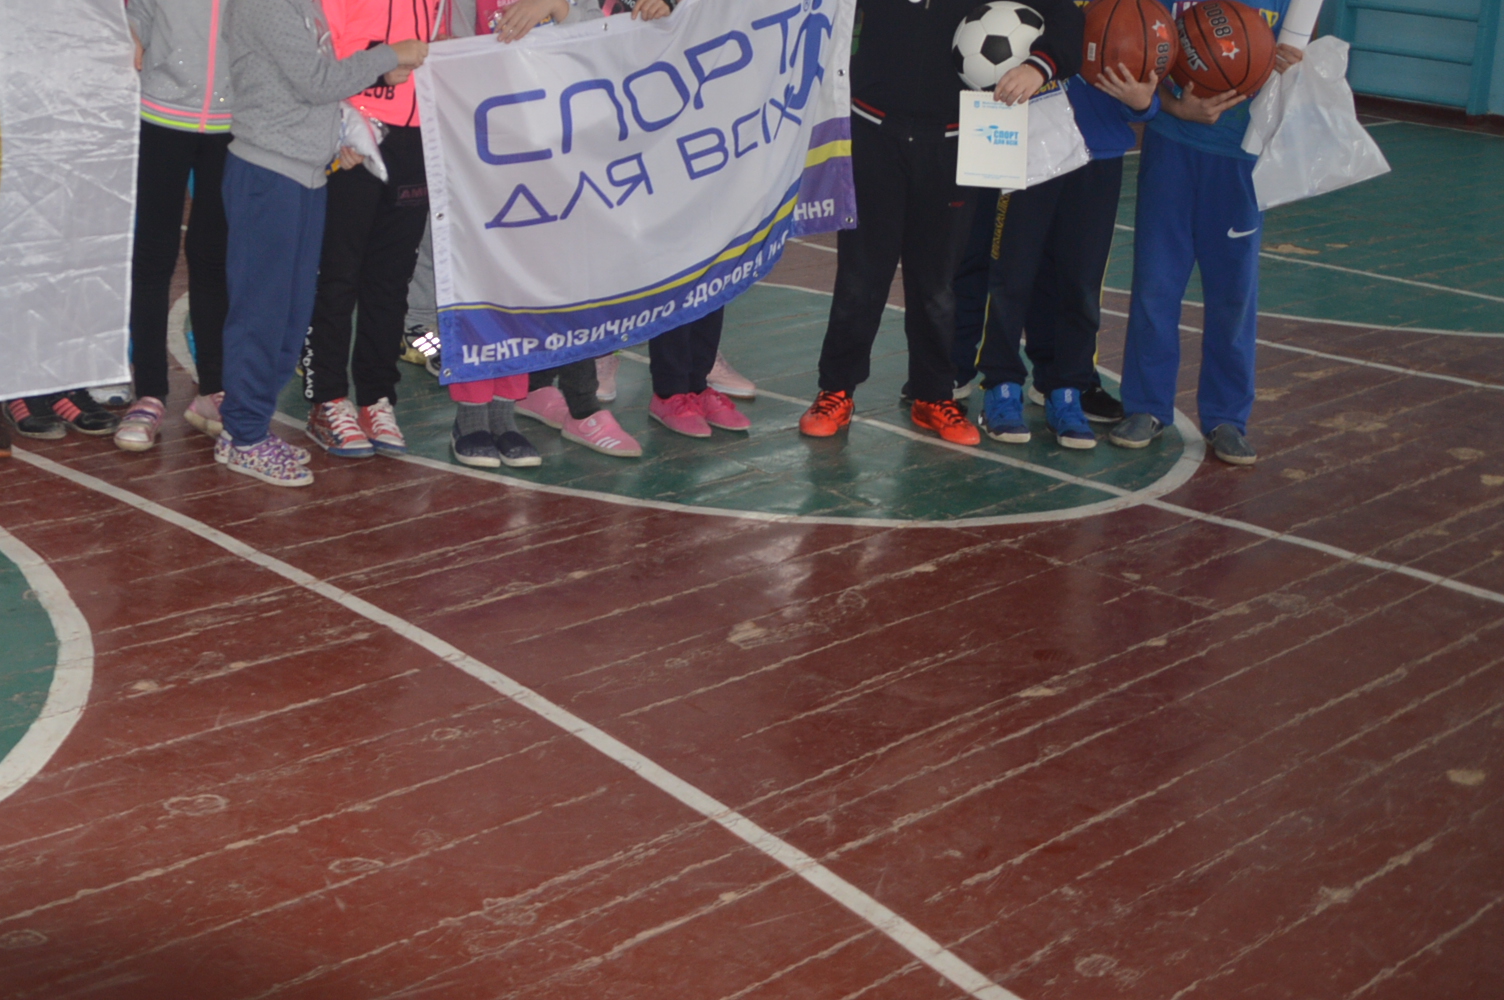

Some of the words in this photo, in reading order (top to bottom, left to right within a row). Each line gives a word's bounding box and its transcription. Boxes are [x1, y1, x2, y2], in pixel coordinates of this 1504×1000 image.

[473, 2, 802, 166] СПОРТ
[485, 152, 654, 229] ДЛЯ
[676, 83, 803, 181] ВСІХ
[462, 338, 539, 366] ЦЕНТР
[545, 300, 675, 351] ФІЗИЧНОГО
